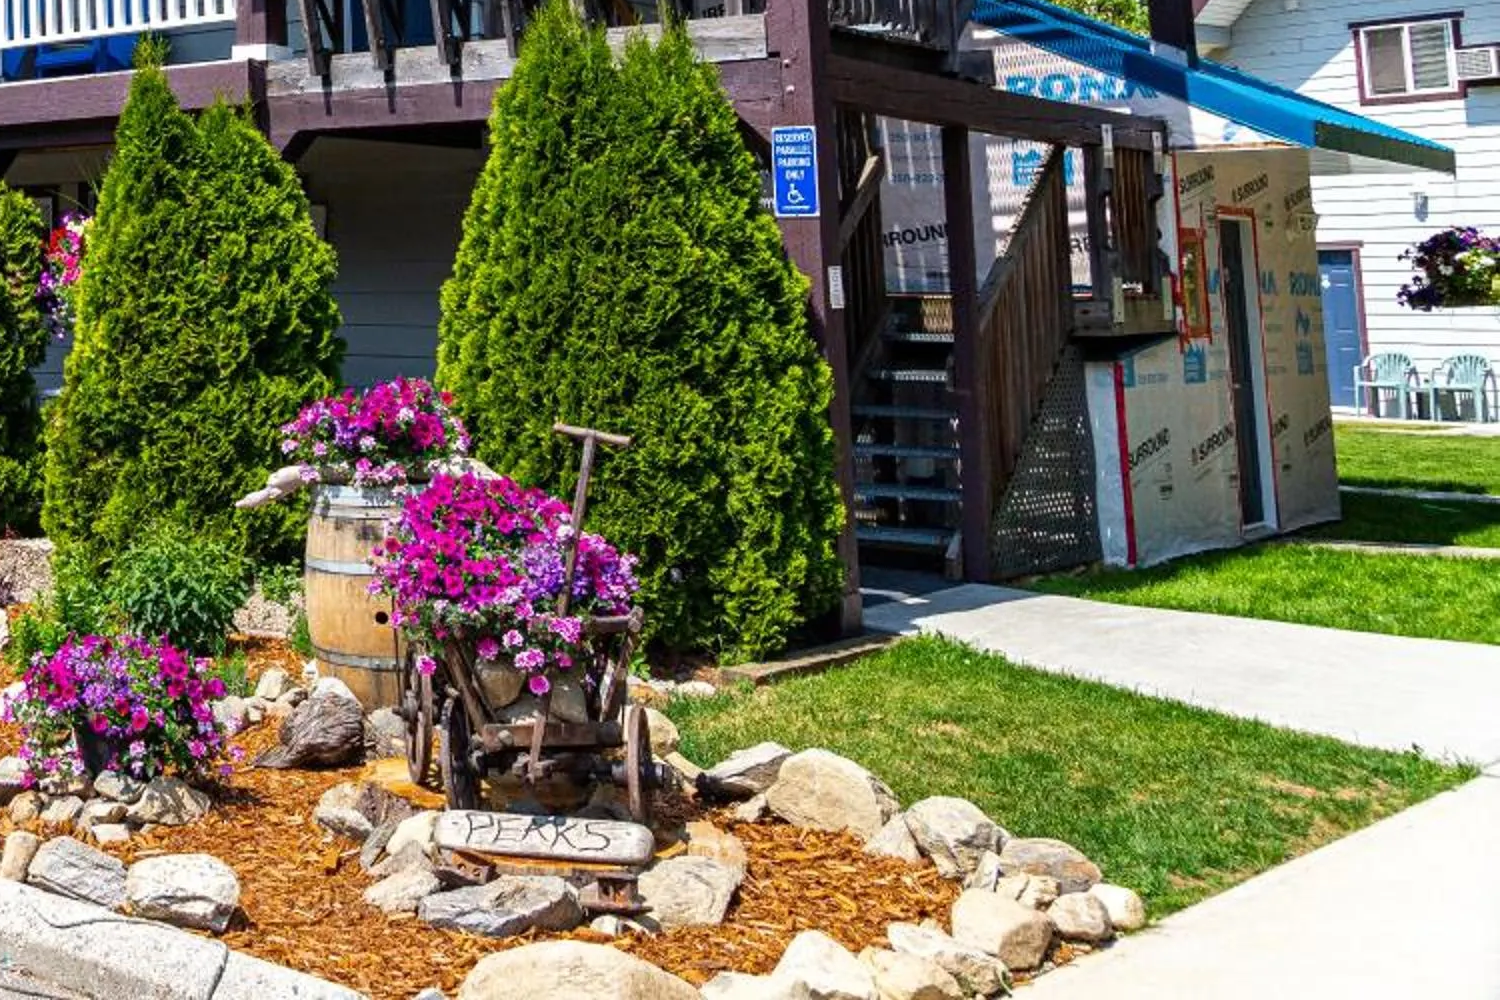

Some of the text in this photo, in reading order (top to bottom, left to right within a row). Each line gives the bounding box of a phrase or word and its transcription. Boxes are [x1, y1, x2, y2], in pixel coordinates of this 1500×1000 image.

[775, 132, 812, 143] RESERVED
[777, 157, 811, 167] PARKING
[785, 169, 805, 180] ONLY
[466, 812, 613, 851] PEAKS
